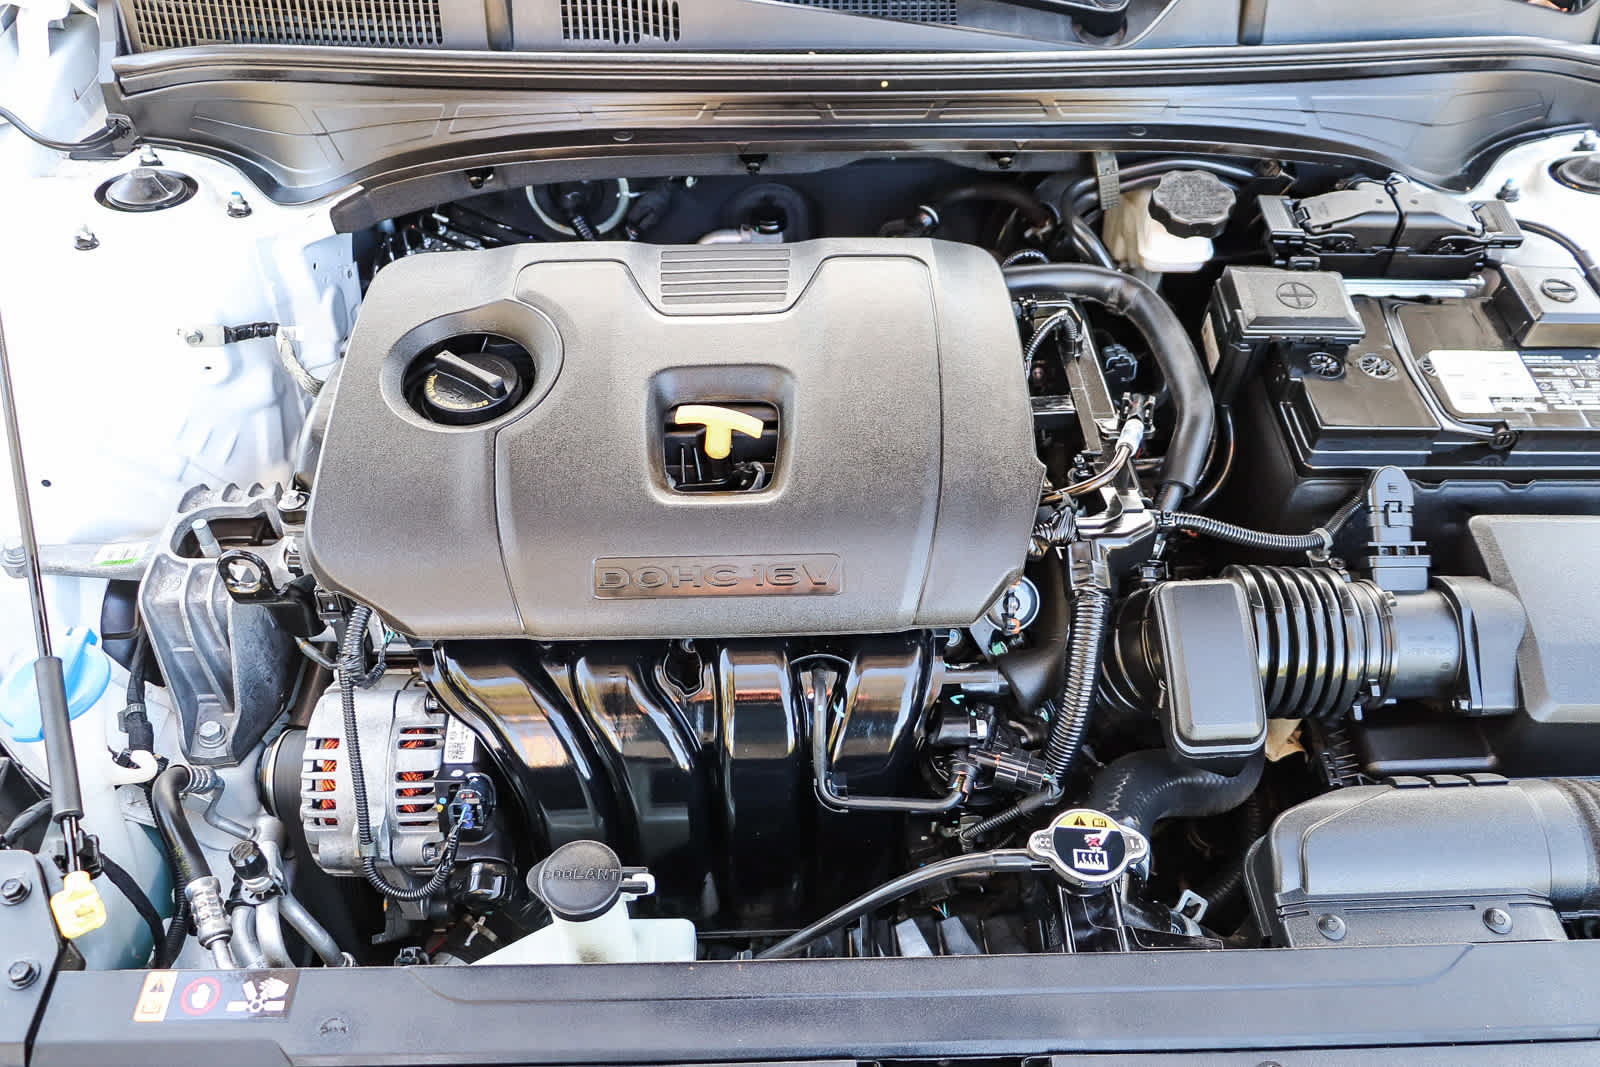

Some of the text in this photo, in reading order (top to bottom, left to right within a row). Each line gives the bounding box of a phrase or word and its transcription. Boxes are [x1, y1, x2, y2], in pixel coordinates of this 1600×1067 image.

[597, 562, 838, 589] DOHC 16V
[1129, 838, 1144, 849] 1.1
